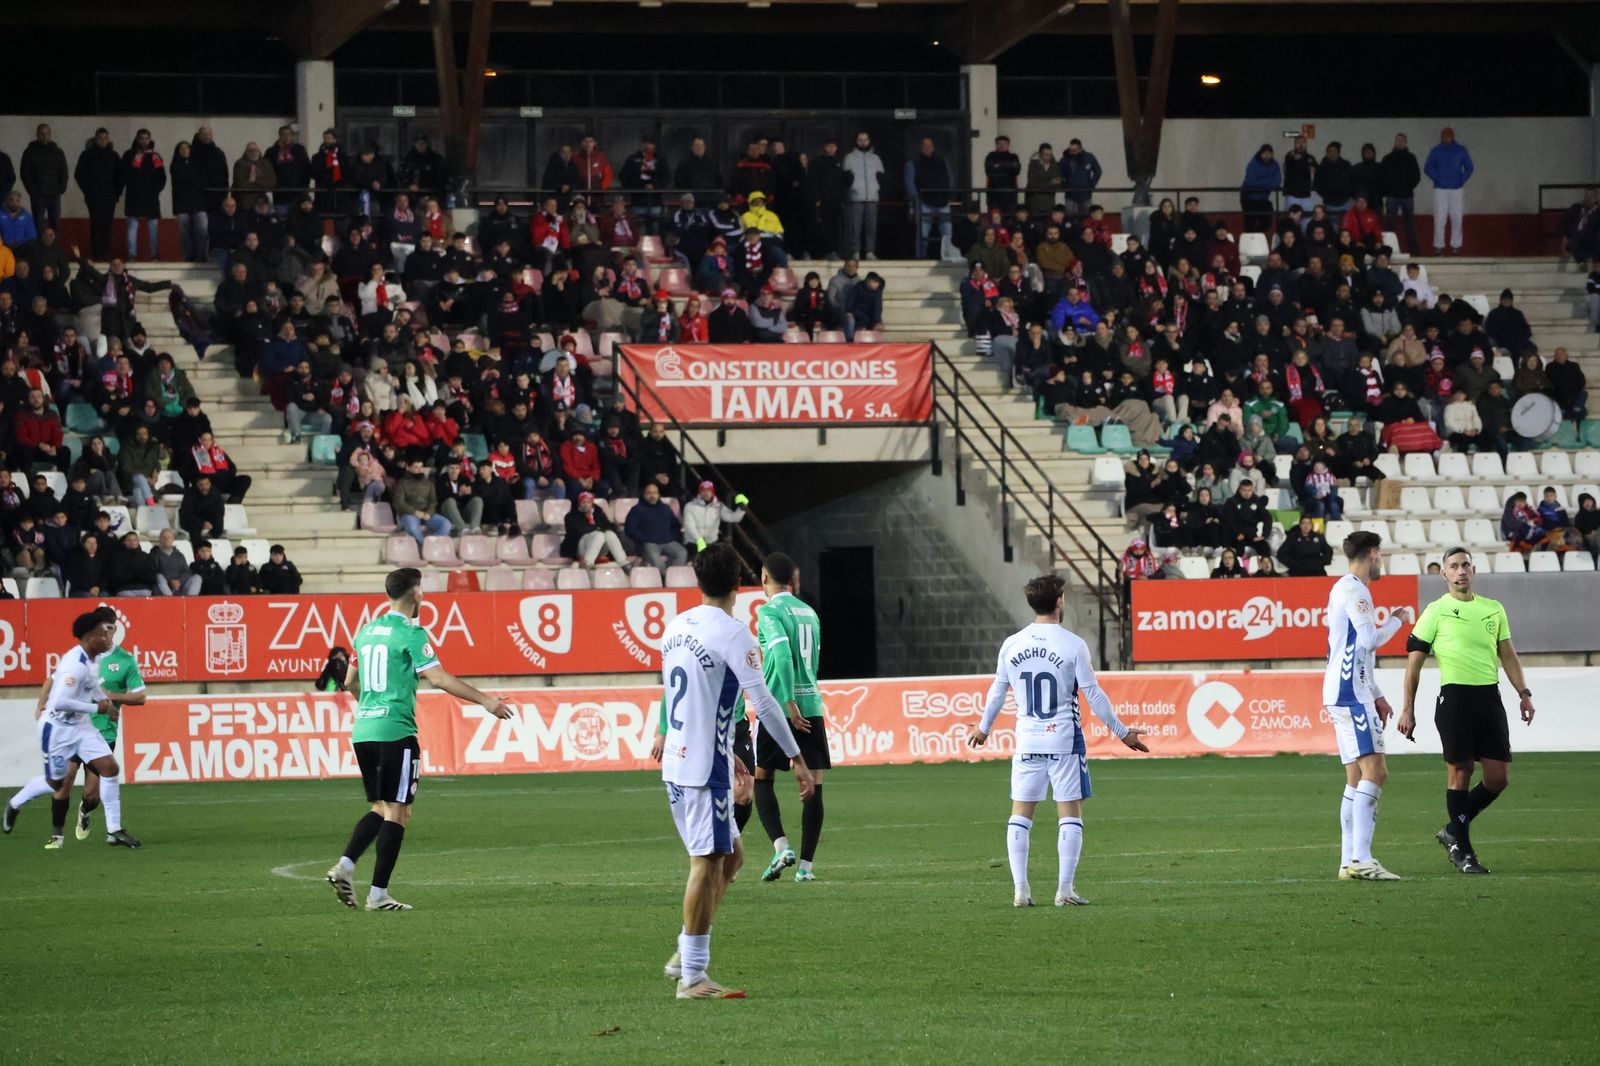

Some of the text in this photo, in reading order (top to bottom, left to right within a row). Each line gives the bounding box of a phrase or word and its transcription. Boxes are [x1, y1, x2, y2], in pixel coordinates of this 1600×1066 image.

[865, 403, 897, 418] S.A.
[538, 603, 561, 642] 8
[643, 601, 666, 640] 8
[506, 622, 547, 670] ZAMORA
[612, 620, 652, 667] ZAMORA
[663, 634, 716, 671] AVID RGUEZ
[798, 624, 812, 670] 4
[1010, 646, 1064, 669] NACHO GIL
[361, 644, 388, 693] 10
[670, 665, 689, 731] 2
[1020, 671, 1058, 719] 10
[1142, 701, 1176, 715] todos
[1249, 699, 1286, 714] COPE
[1090, 722, 1108, 737] los
[1162, 724, 1177, 737] en
[1251, 715, 1312, 730] ZAMORA
[51, 755, 64, 768] 12
